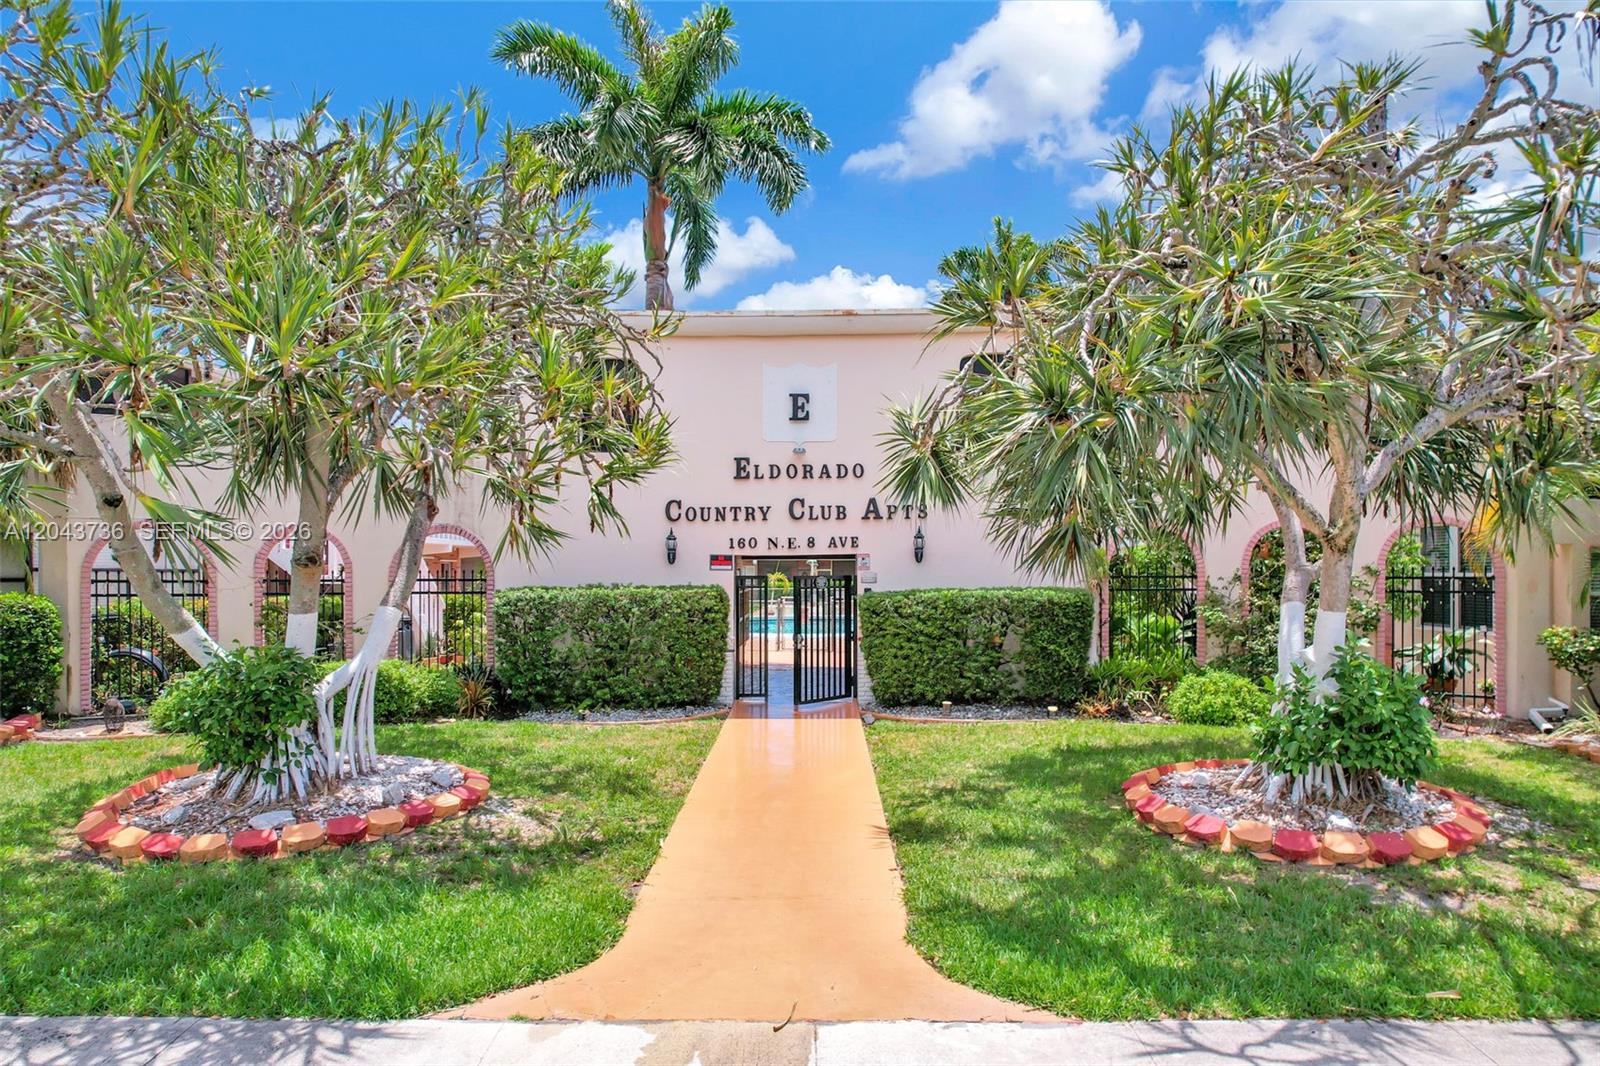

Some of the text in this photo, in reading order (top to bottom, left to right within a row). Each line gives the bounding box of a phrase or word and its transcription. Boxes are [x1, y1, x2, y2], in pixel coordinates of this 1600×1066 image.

[789, 393, 811, 421] E
[733, 457, 866, 480] ELDORADO
[665, 500, 772, 522] COUNTRY
[788, 498, 848, 520] CLUB
[728, 537, 758, 550] 160
[807, 536, 816, 548] 8
[828, 536, 860, 549] AVE
